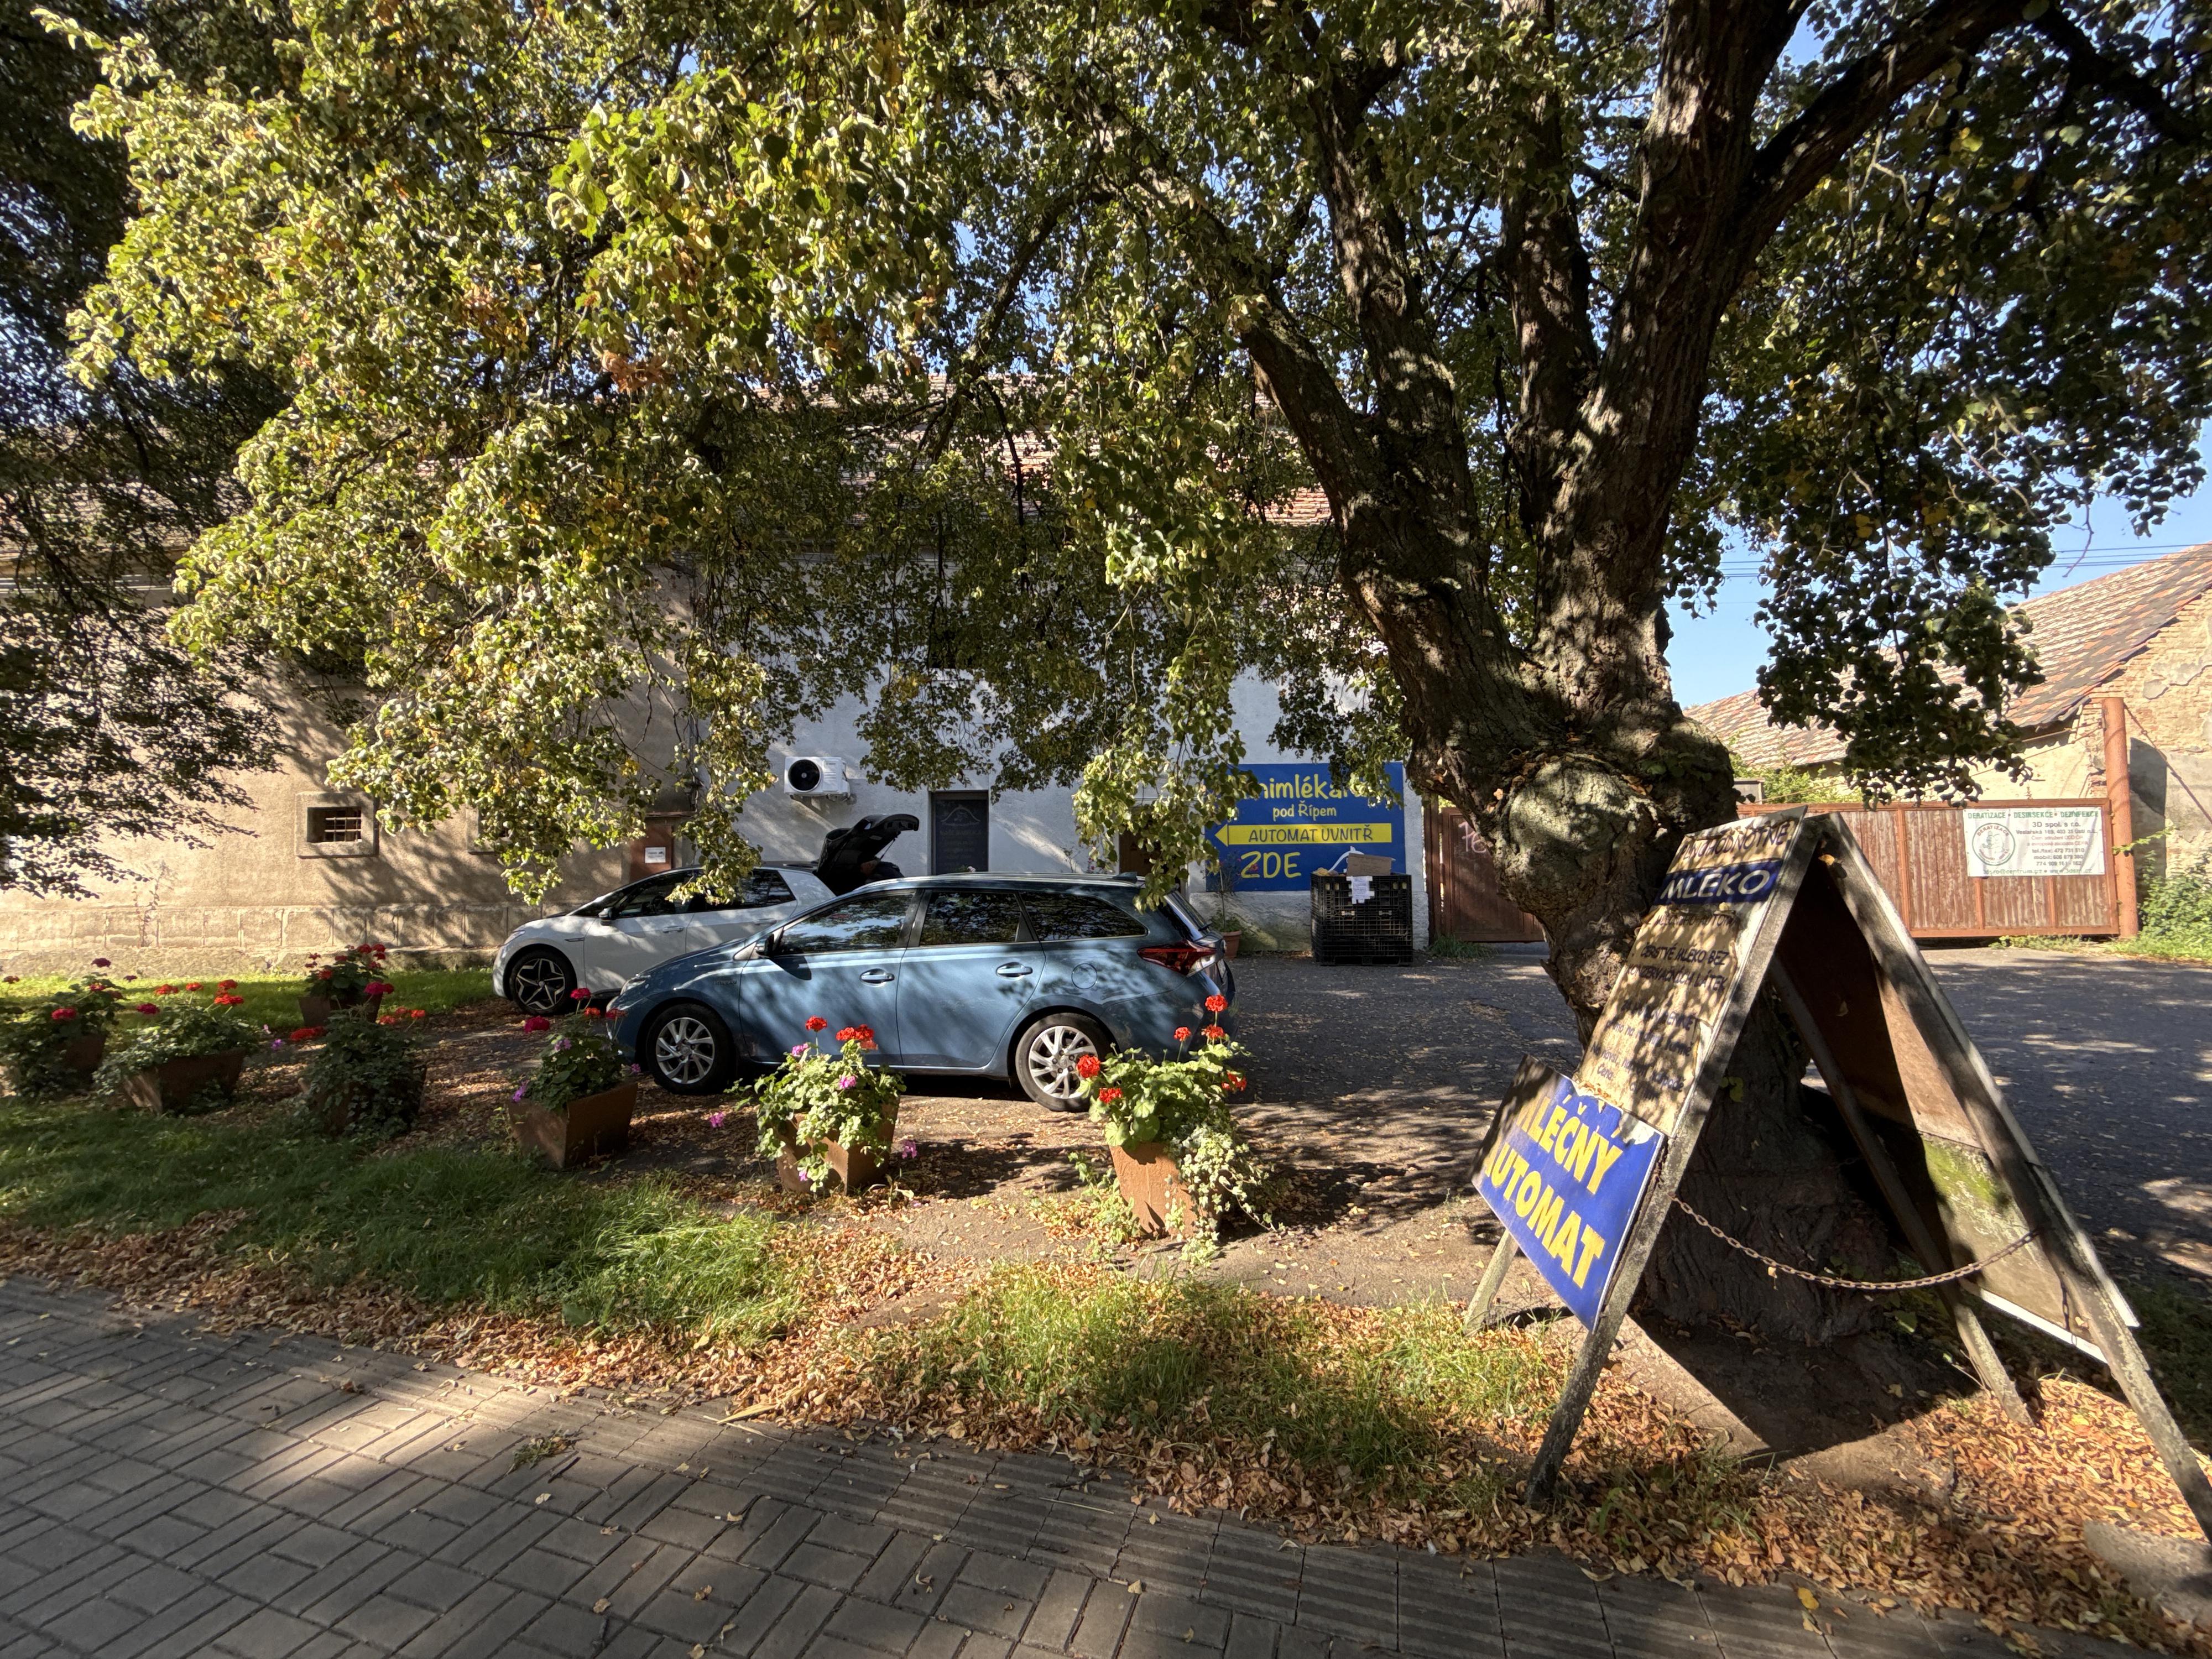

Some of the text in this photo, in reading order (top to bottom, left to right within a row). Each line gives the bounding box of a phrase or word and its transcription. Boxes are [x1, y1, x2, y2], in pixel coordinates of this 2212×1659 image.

[1272, 800, 1337, 822] pod Řípem
[1248, 825, 1373, 843] AUTOMAT UVNITŘ
[1240, 851, 1302, 879] ZDE
